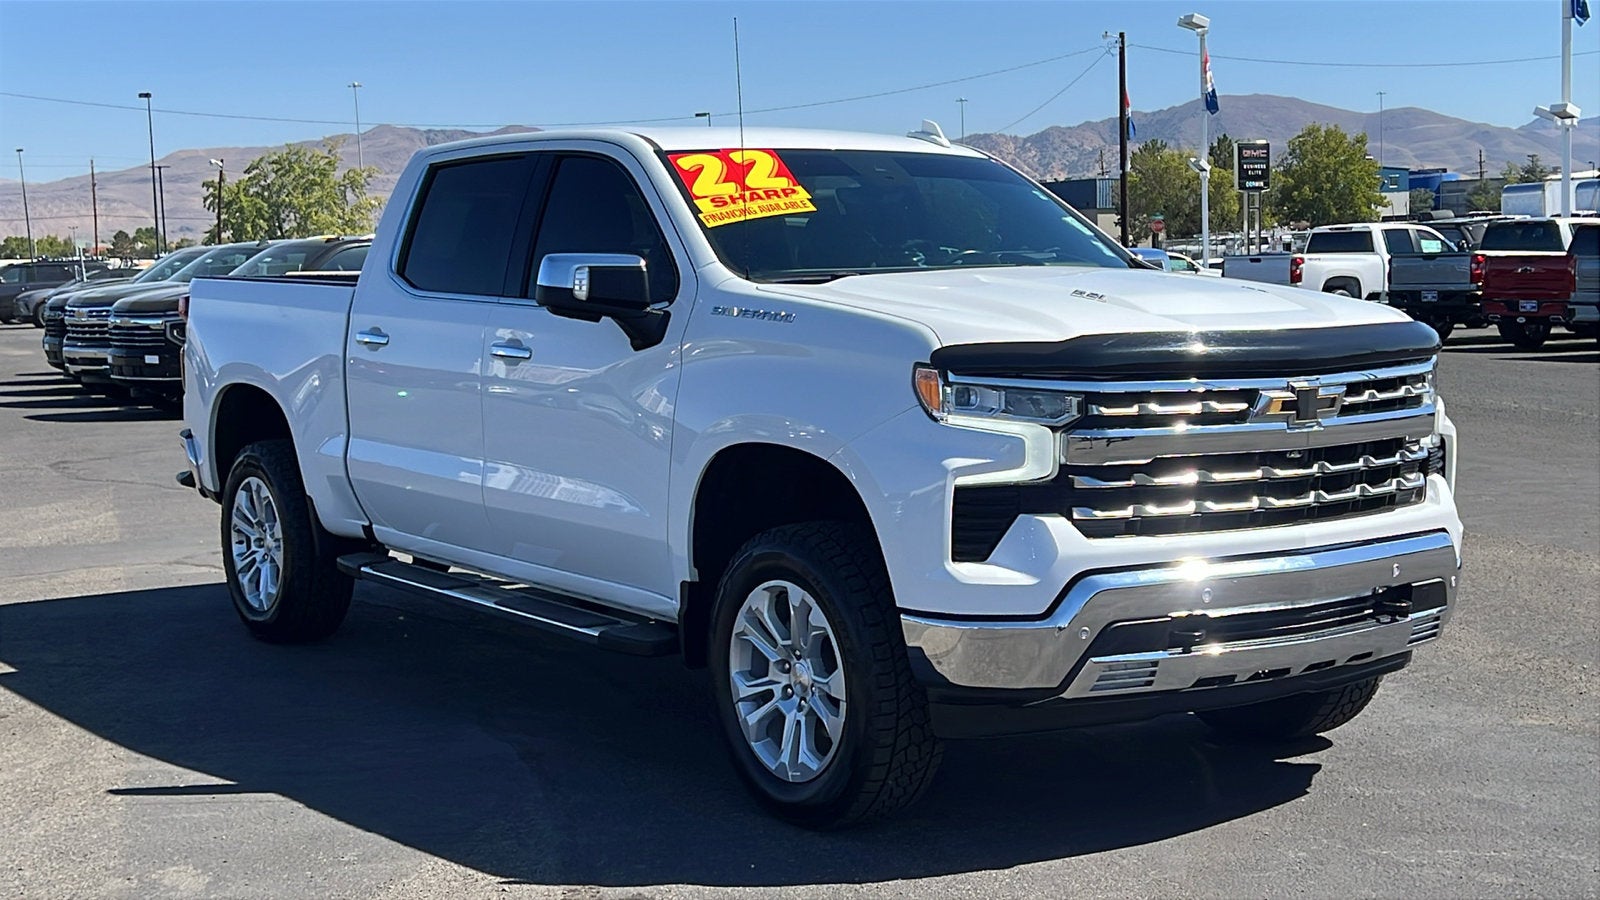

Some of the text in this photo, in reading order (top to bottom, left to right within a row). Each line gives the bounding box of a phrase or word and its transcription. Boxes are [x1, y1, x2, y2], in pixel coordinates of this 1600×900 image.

[1242, 149, 1268, 158] GMC
[676, 150, 793, 198] 22
[710, 187, 798, 208] SHARP
[703, 199, 809, 224] FINANCING AVAILABLE
